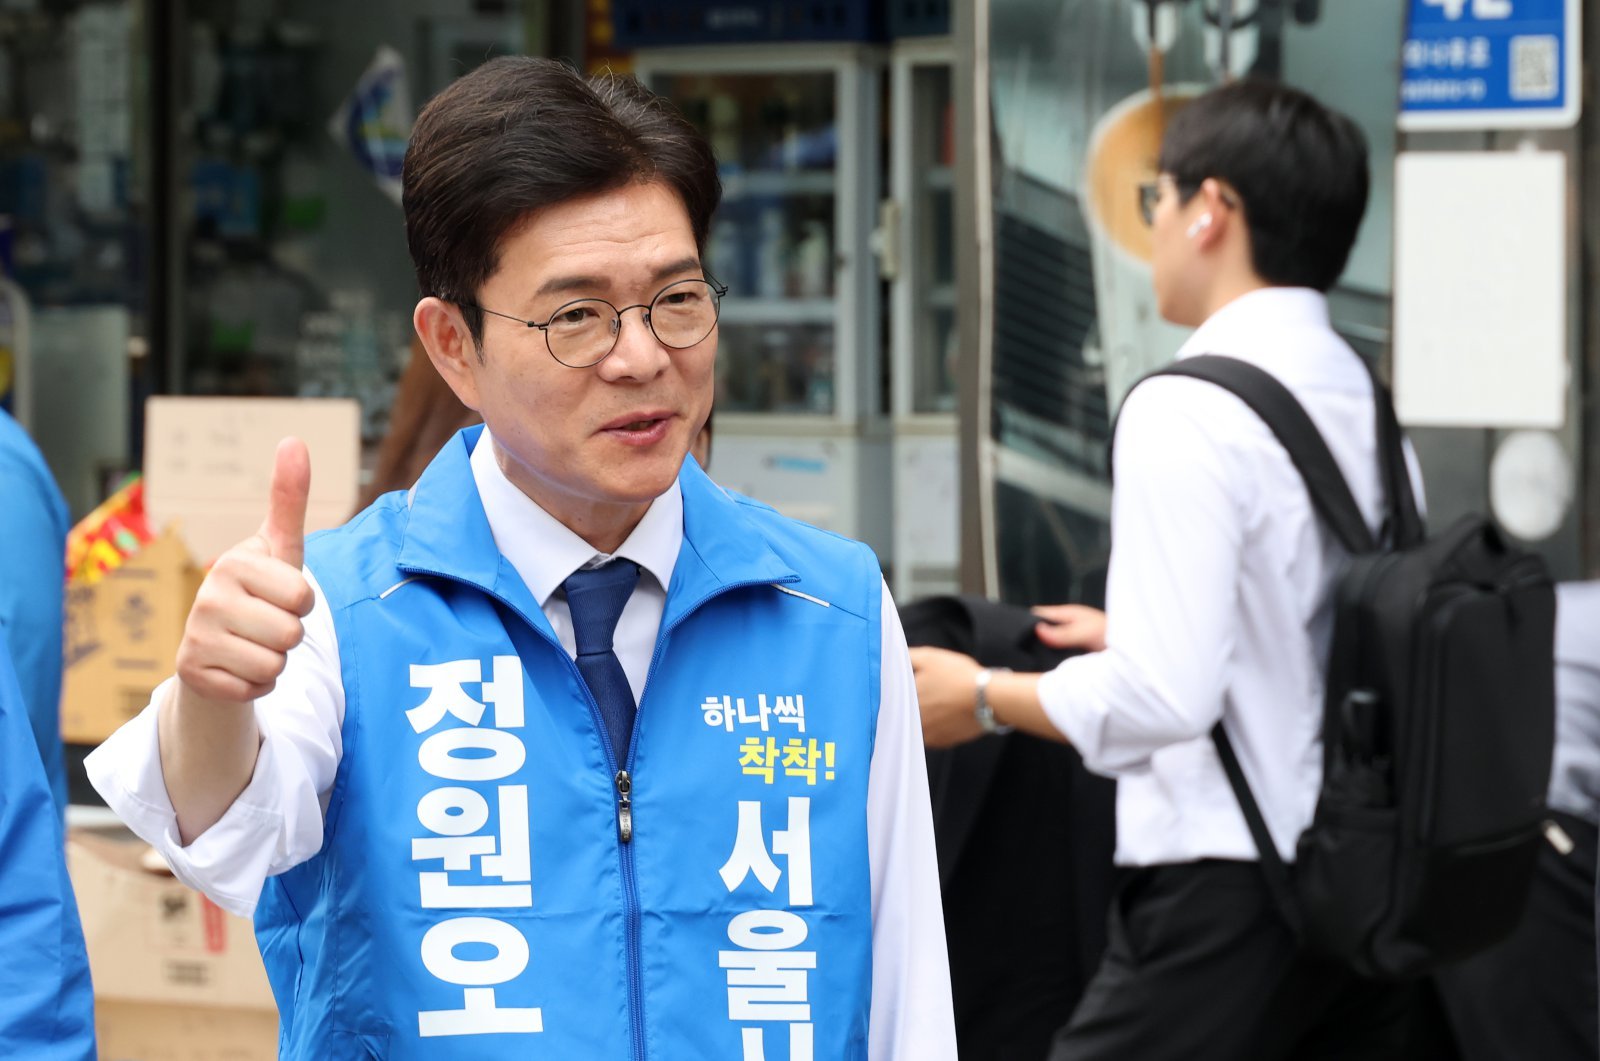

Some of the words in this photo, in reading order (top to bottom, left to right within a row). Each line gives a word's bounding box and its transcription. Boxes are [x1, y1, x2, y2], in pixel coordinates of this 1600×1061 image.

[701, 694, 806, 732] 하나씩
[738, 736, 836, 785] 착착!
[405, 655, 543, 1037] 정원오
